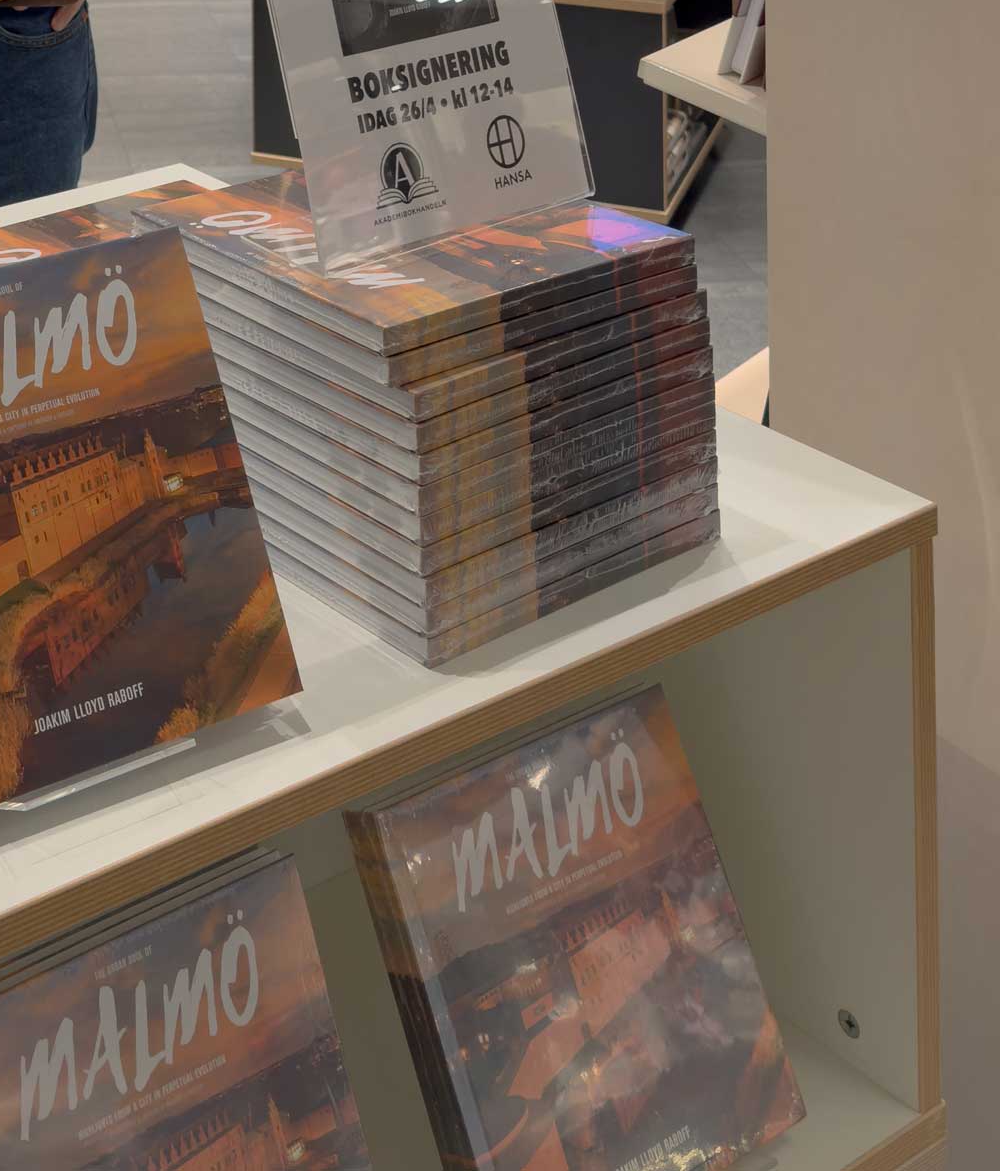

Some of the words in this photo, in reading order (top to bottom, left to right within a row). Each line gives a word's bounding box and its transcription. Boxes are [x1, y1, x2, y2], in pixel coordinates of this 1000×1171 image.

[348, 40, 510, 103] BOKSIGNERING
[357, 106, 397, 134] IDAG
[400, 96, 437, 122] 26/4
[451, 89, 468, 110] kl
[470, 77, 514, 105] 12-14
[494, 169, 533, 190] HANSA
[373, 199, 447, 226] AKADEMIBOKHANDELN
[15, 281, 24, 292] OF
[0, 414, 4, 422] A
[5, 409, 20, 422] CITY
[21, 407, 29, 417] IN
[30, 398, 65, 414] PERPETUAL
[66, 387, 101, 405] EVOLUTION
[34, 708, 72, 735] JOAKIM
[73, 696, 105, 720] LLOYD
[107, 682, 144, 708] RABOFF
[452, 729, 644, 913] MALMÖ
[19, 908, 260, 1141] MALMÖ
[113, 1105, 132, 1123] FROM
[139, 1093, 152, 1109] CITY
[194, 1054, 227, 1079] EVOLUTION
[663, 1124, 691, 1151] RABOFF
